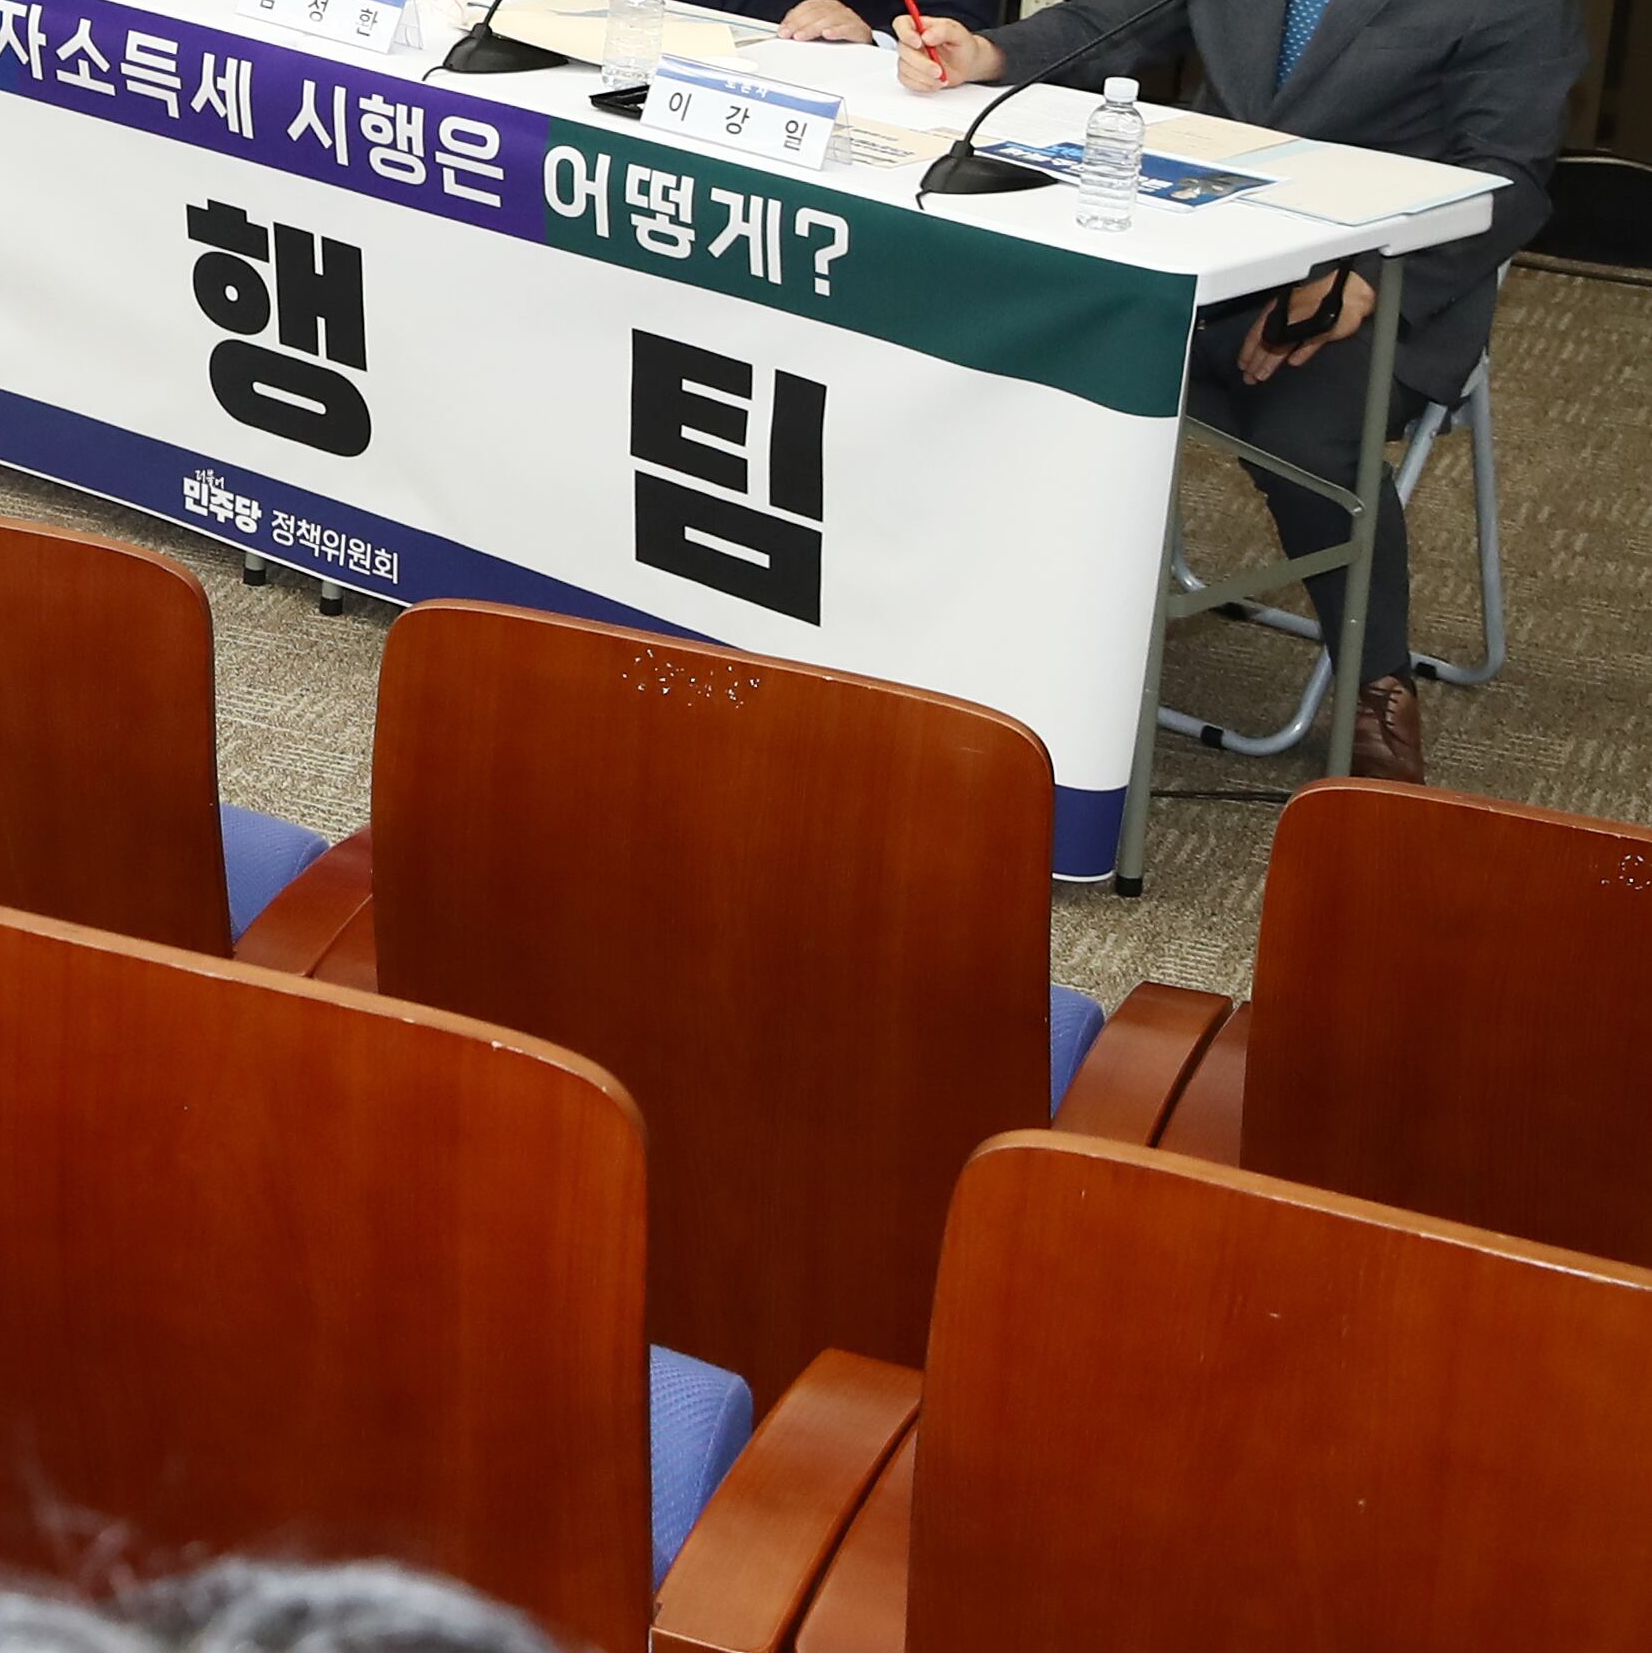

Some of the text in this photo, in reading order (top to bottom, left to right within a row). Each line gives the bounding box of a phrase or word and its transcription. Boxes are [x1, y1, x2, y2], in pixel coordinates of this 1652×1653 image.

[286, 77, 506, 209] 시행은
[542, 143, 850, 298] 어떻게?
[182, 476, 399, 585] 민주당 정책위원회
